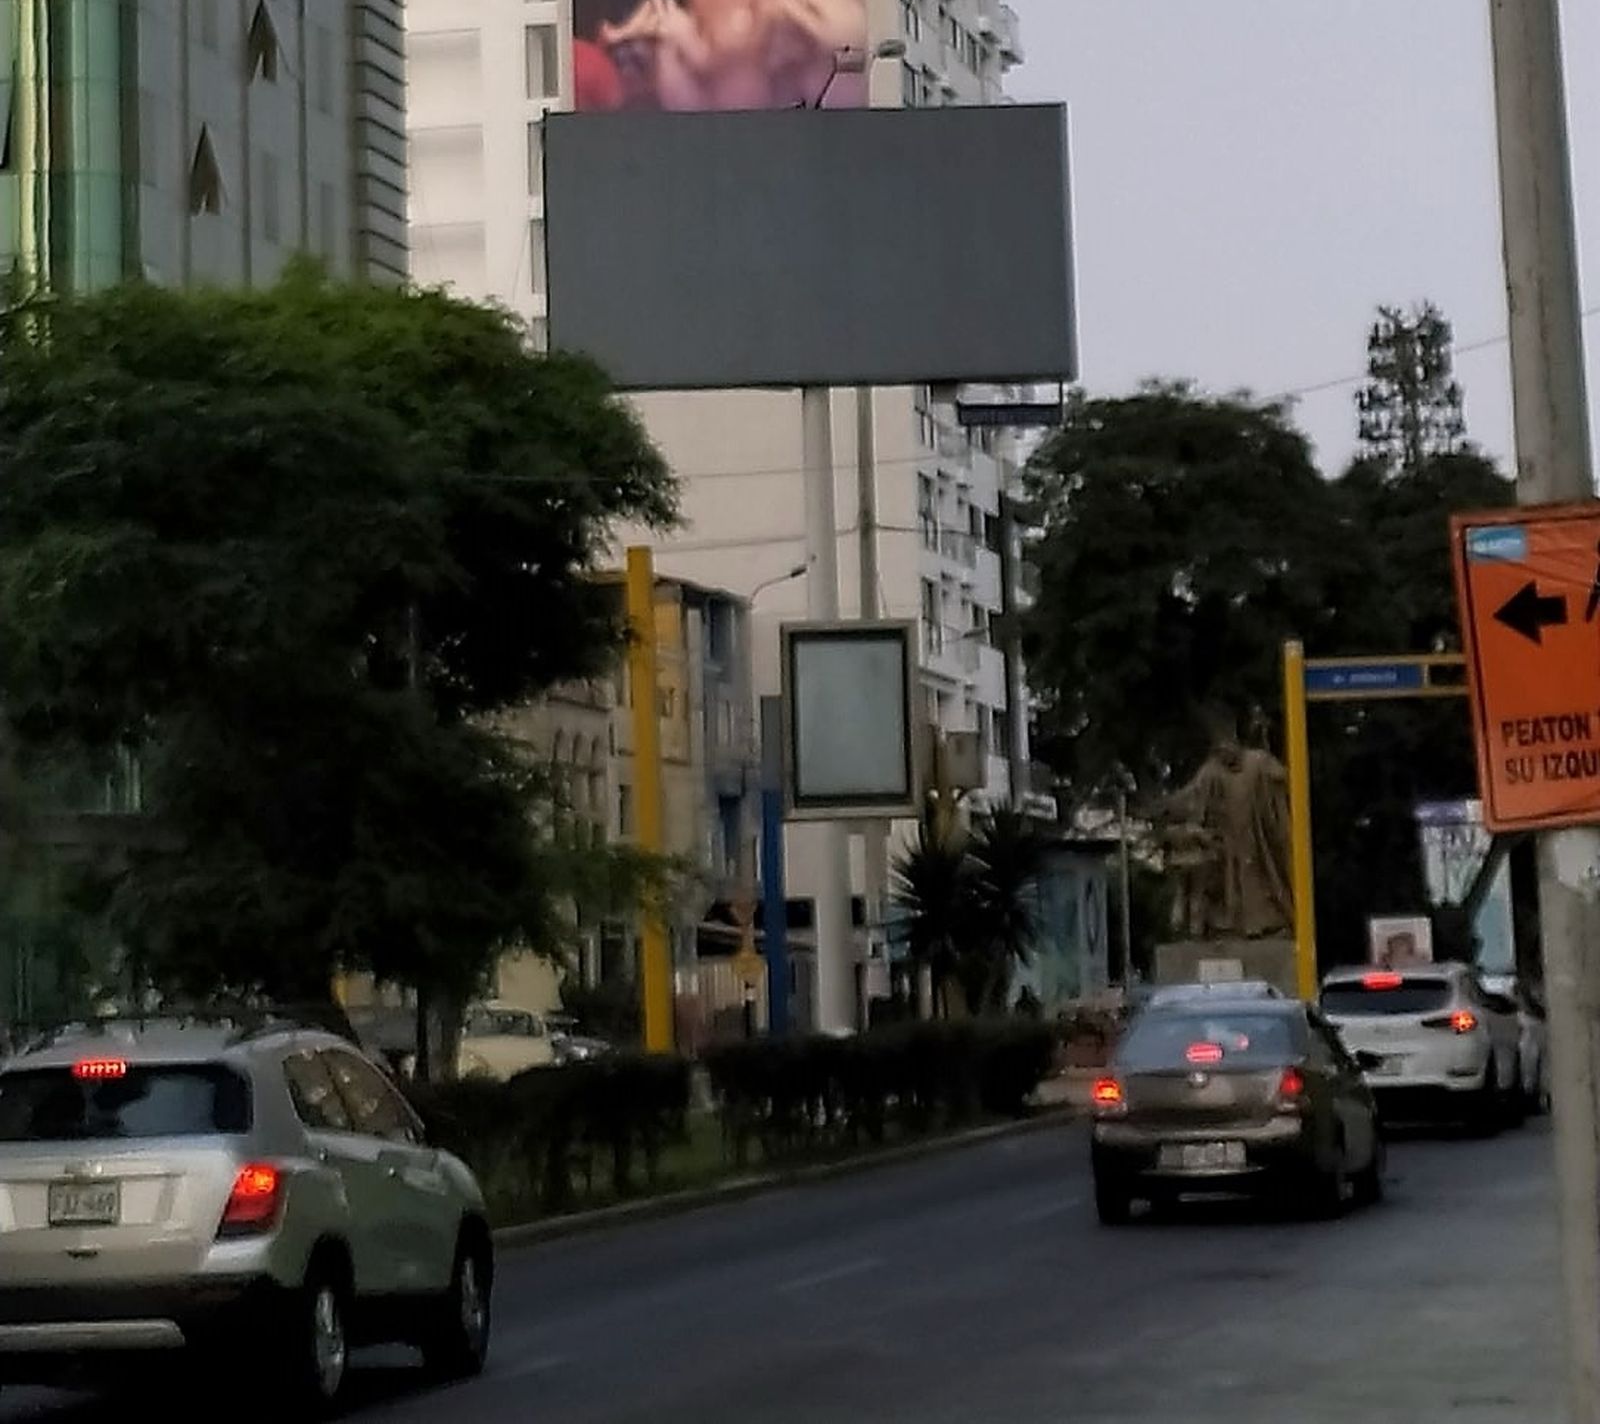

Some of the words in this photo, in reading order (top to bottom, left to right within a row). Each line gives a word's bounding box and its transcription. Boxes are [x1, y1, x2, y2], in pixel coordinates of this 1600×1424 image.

[1501, 712, 1591, 747] PEATON
[1505, 757, 1535, 785] SU
[1542, 749, 1600, 782] IZQU
